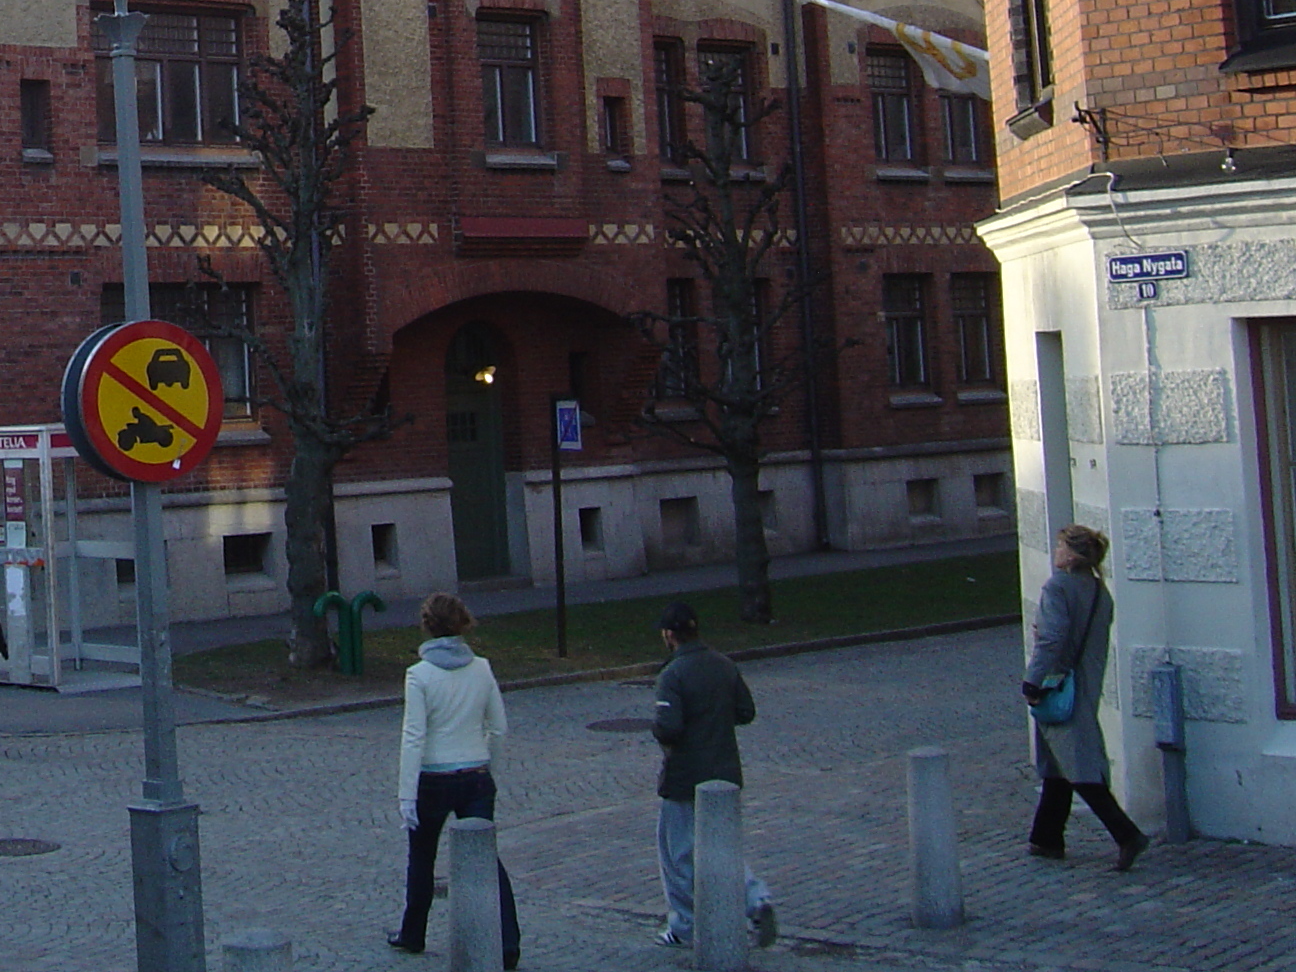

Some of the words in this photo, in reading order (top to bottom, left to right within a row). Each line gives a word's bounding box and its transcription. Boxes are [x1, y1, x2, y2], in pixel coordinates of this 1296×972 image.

[1111, 260, 1141, 277] Haga
[1142, 256, 1183, 275] Nygata
[1142, 283, 1154, 298] 10
